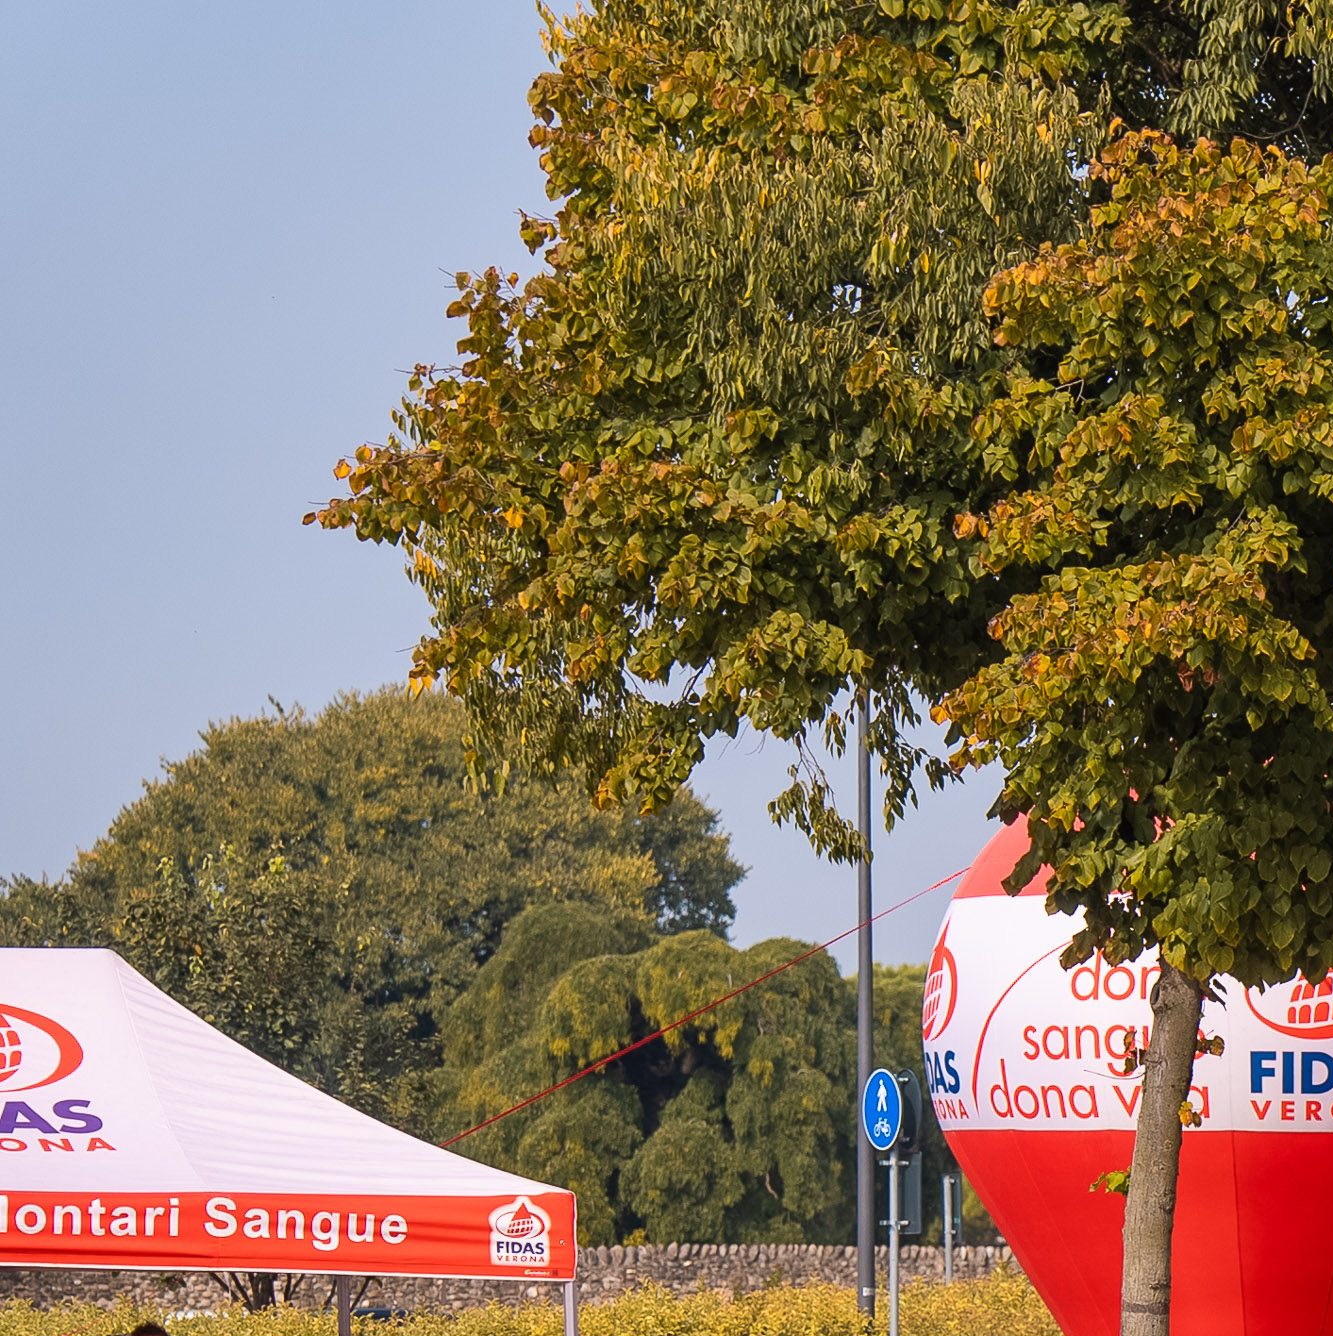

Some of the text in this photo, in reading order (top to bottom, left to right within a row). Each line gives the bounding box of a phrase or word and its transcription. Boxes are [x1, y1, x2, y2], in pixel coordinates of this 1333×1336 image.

[1071, 948, 1165, 1001] don
[990, 1058, 1099, 1119] dona
[203, 1196, 408, 1251] Sangue
[496, 1241, 545, 1255] FIDAS
[497, 1255, 545, 1263] VERONA
